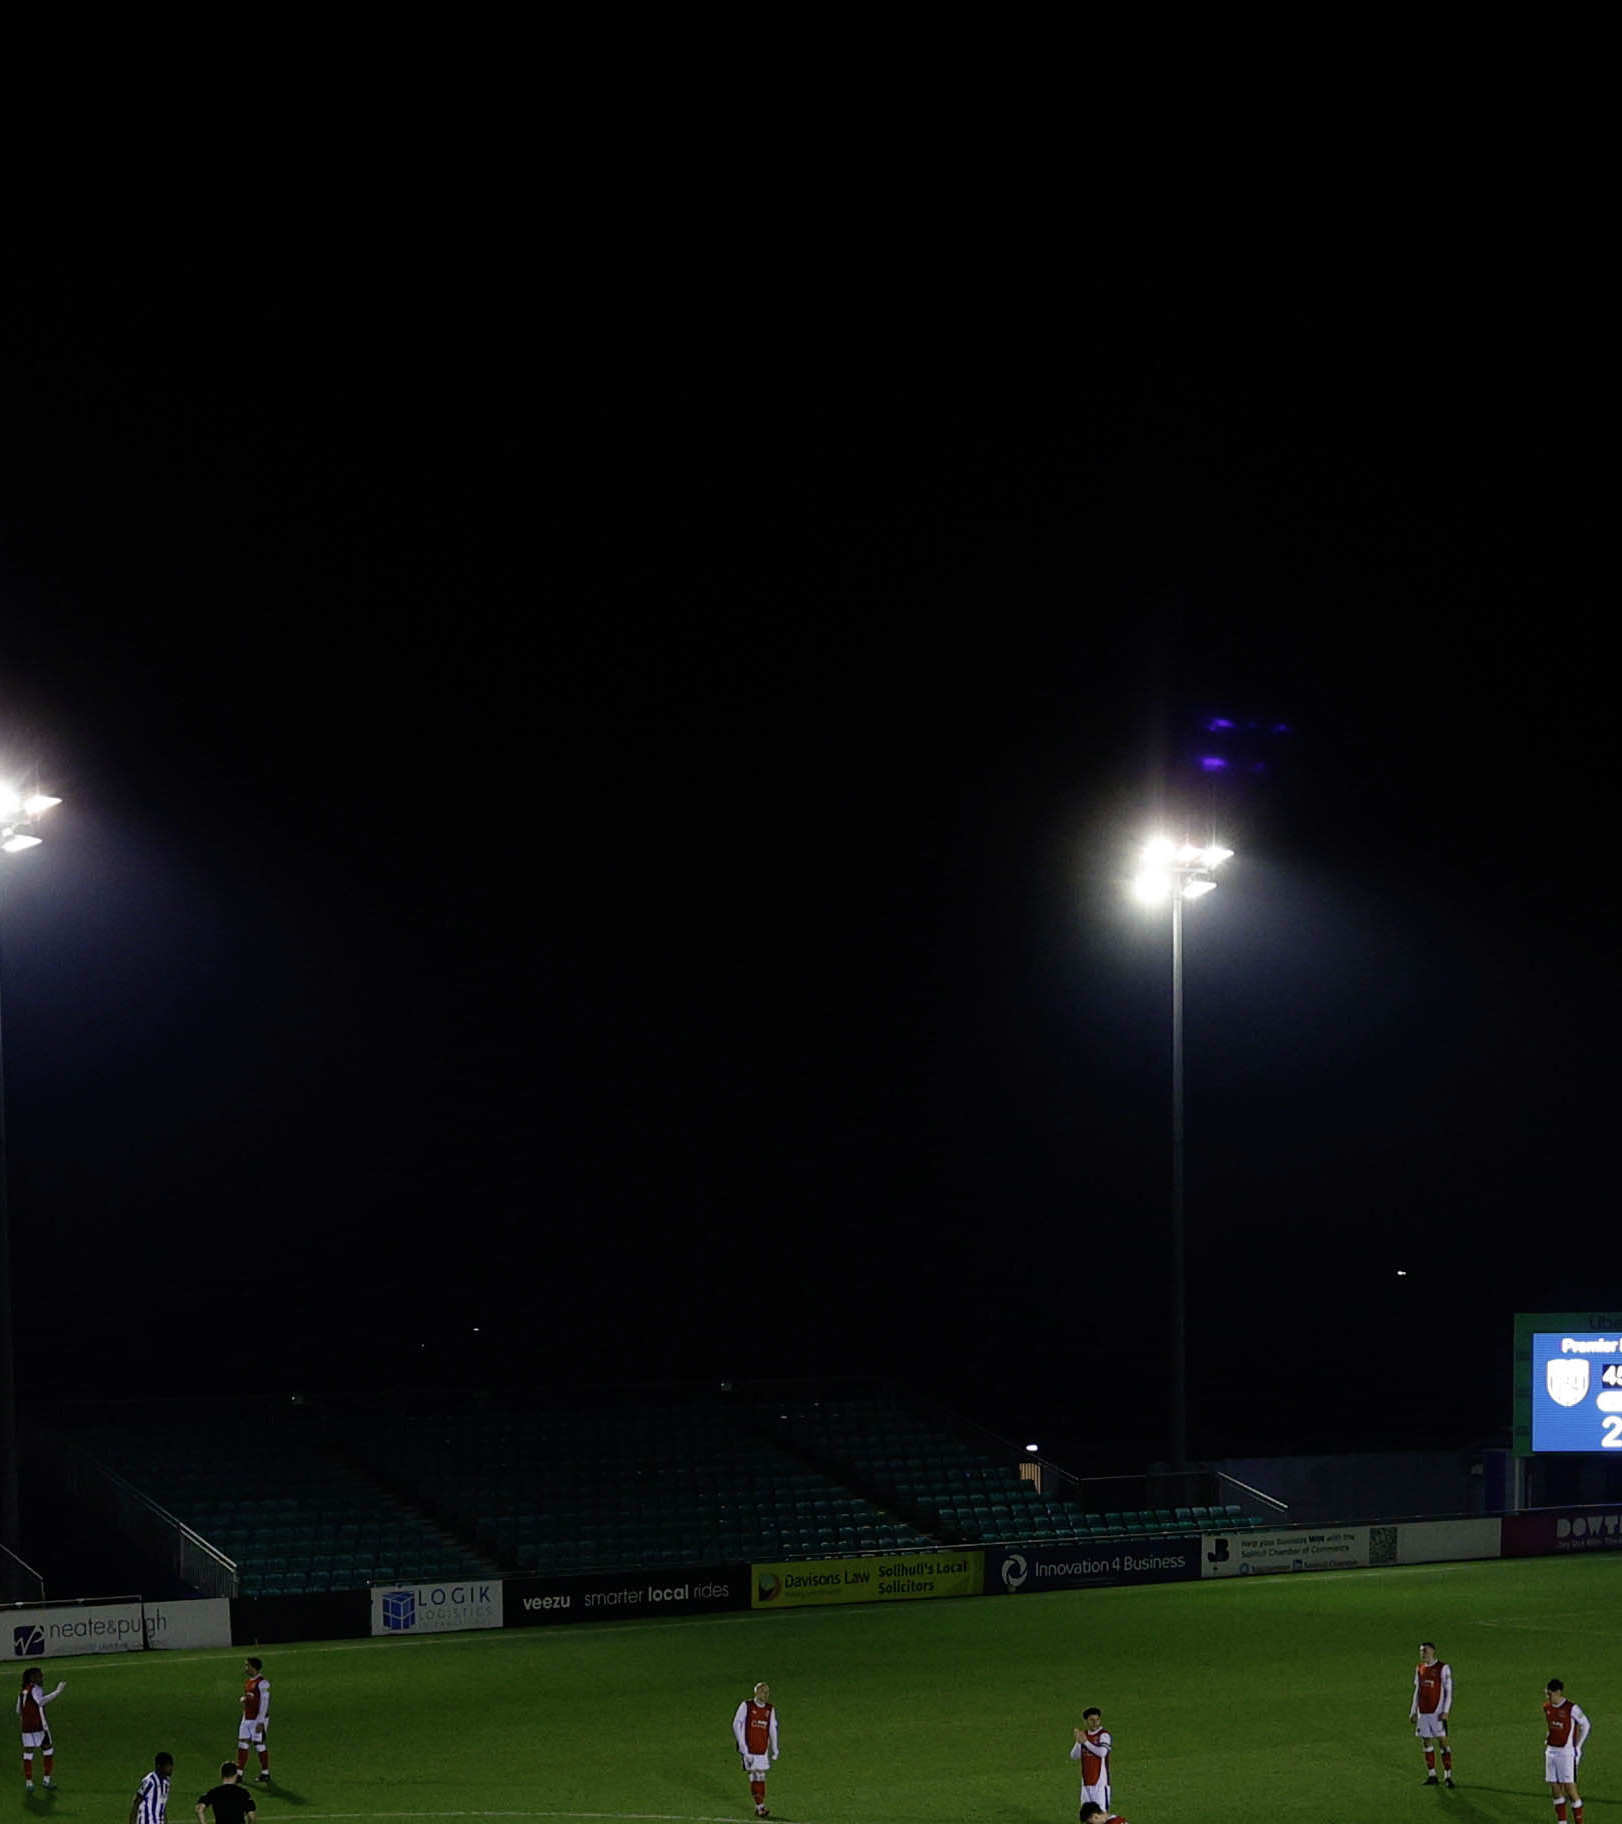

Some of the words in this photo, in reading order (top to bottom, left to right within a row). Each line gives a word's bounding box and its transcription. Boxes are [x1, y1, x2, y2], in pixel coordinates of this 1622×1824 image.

[1561, 1338, 1619, 1353] Premier
[879, 1560, 934, 1577] Solihull's
[936, 1560, 968, 1574] Local
[1035, 1557, 1110, 1577] Innovation
[1112, 1556, 1122, 1571] 4
[1124, 1553, 1186, 1572] Business
[784, 1573, 841, 1589] Davisons
[845, 1570, 870, 1585] Law
[879, 1578, 935, 1593] Solicitors
[418, 1586, 490, 1607] LOGIK
[522, 1594, 572, 1611] veezu
[584, 1588, 644, 1607] smarter
[648, 1583, 690, 1602] local
[693, 1581, 730, 1599] rides
